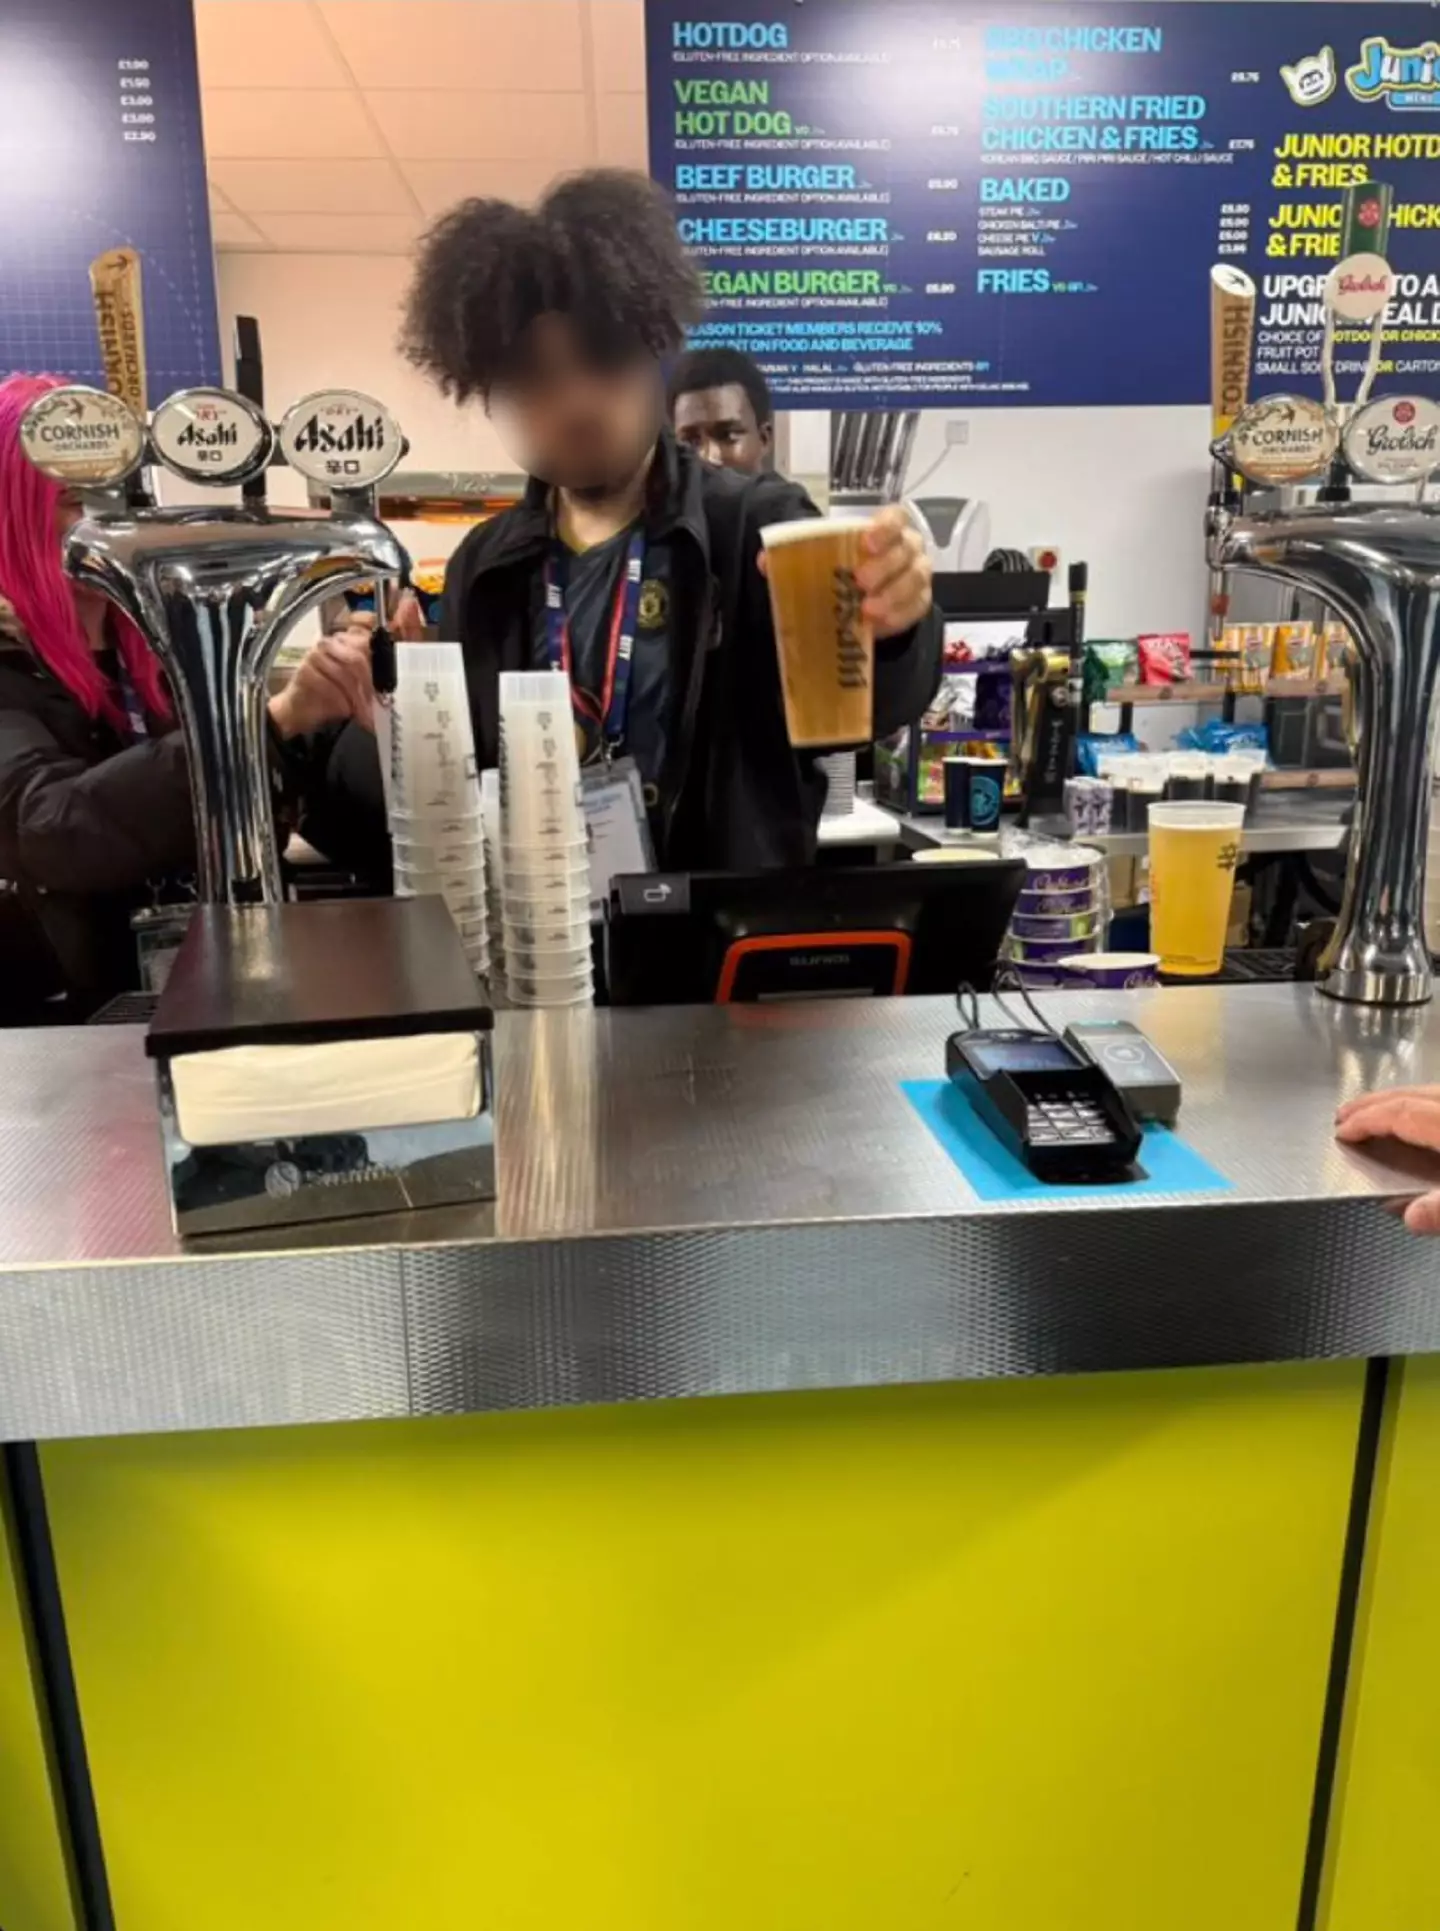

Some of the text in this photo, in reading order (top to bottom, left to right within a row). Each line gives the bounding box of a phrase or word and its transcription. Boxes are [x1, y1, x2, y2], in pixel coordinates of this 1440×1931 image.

[672, 22, 787, 48] HOTDOG
[1046, 27, 1162, 52] CHICKEN
[674, 80, 769, 104] VEGAN
[981, 95, 1206, 121] SOUTHERN FRIED
[675, 111, 731, 135] HOT
[735, 111, 792, 135] DOG
[980, 126, 1198, 150] CHICKEN & FRIES
[1274, 133, 1370, 158] JUNIOR
[676, 165, 856, 189] BEEF BURGER
[1272, 164, 1368, 188] & FRIES
[979, 178, 1070, 202] BAKED
[1268, 204, 1440, 229] JUNIO HICK
[677, 218, 888, 242] CHEESEBURGER
[1266, 233, 1341, 257] & FRIE
[700, 271, 769, 295] EGAN
[774, 271, 880, 295] BURGER
[978, 269, 1050, 293] FRIES
[1421, 275, 1440, 296] A
[1382, 303, 1431, 325] EAL
[93, 290, 123, 396] ORNISH
[1257, 331, 1304, 343] CHOICE
[1222, 305, 1249, 417] CORNISH
[1257, 345, 1320, 359] FRUIT POT
[1300, 361, 1322, 374] SO
[1335, 360, 1367, 374] DRIN
[40, 423, 120, 442] CORNISH
[176, 421, 238, 447] Asahi
[294, 413, 384, 453] Asahi
[1252, 429, 1324, 446] CORNISH
